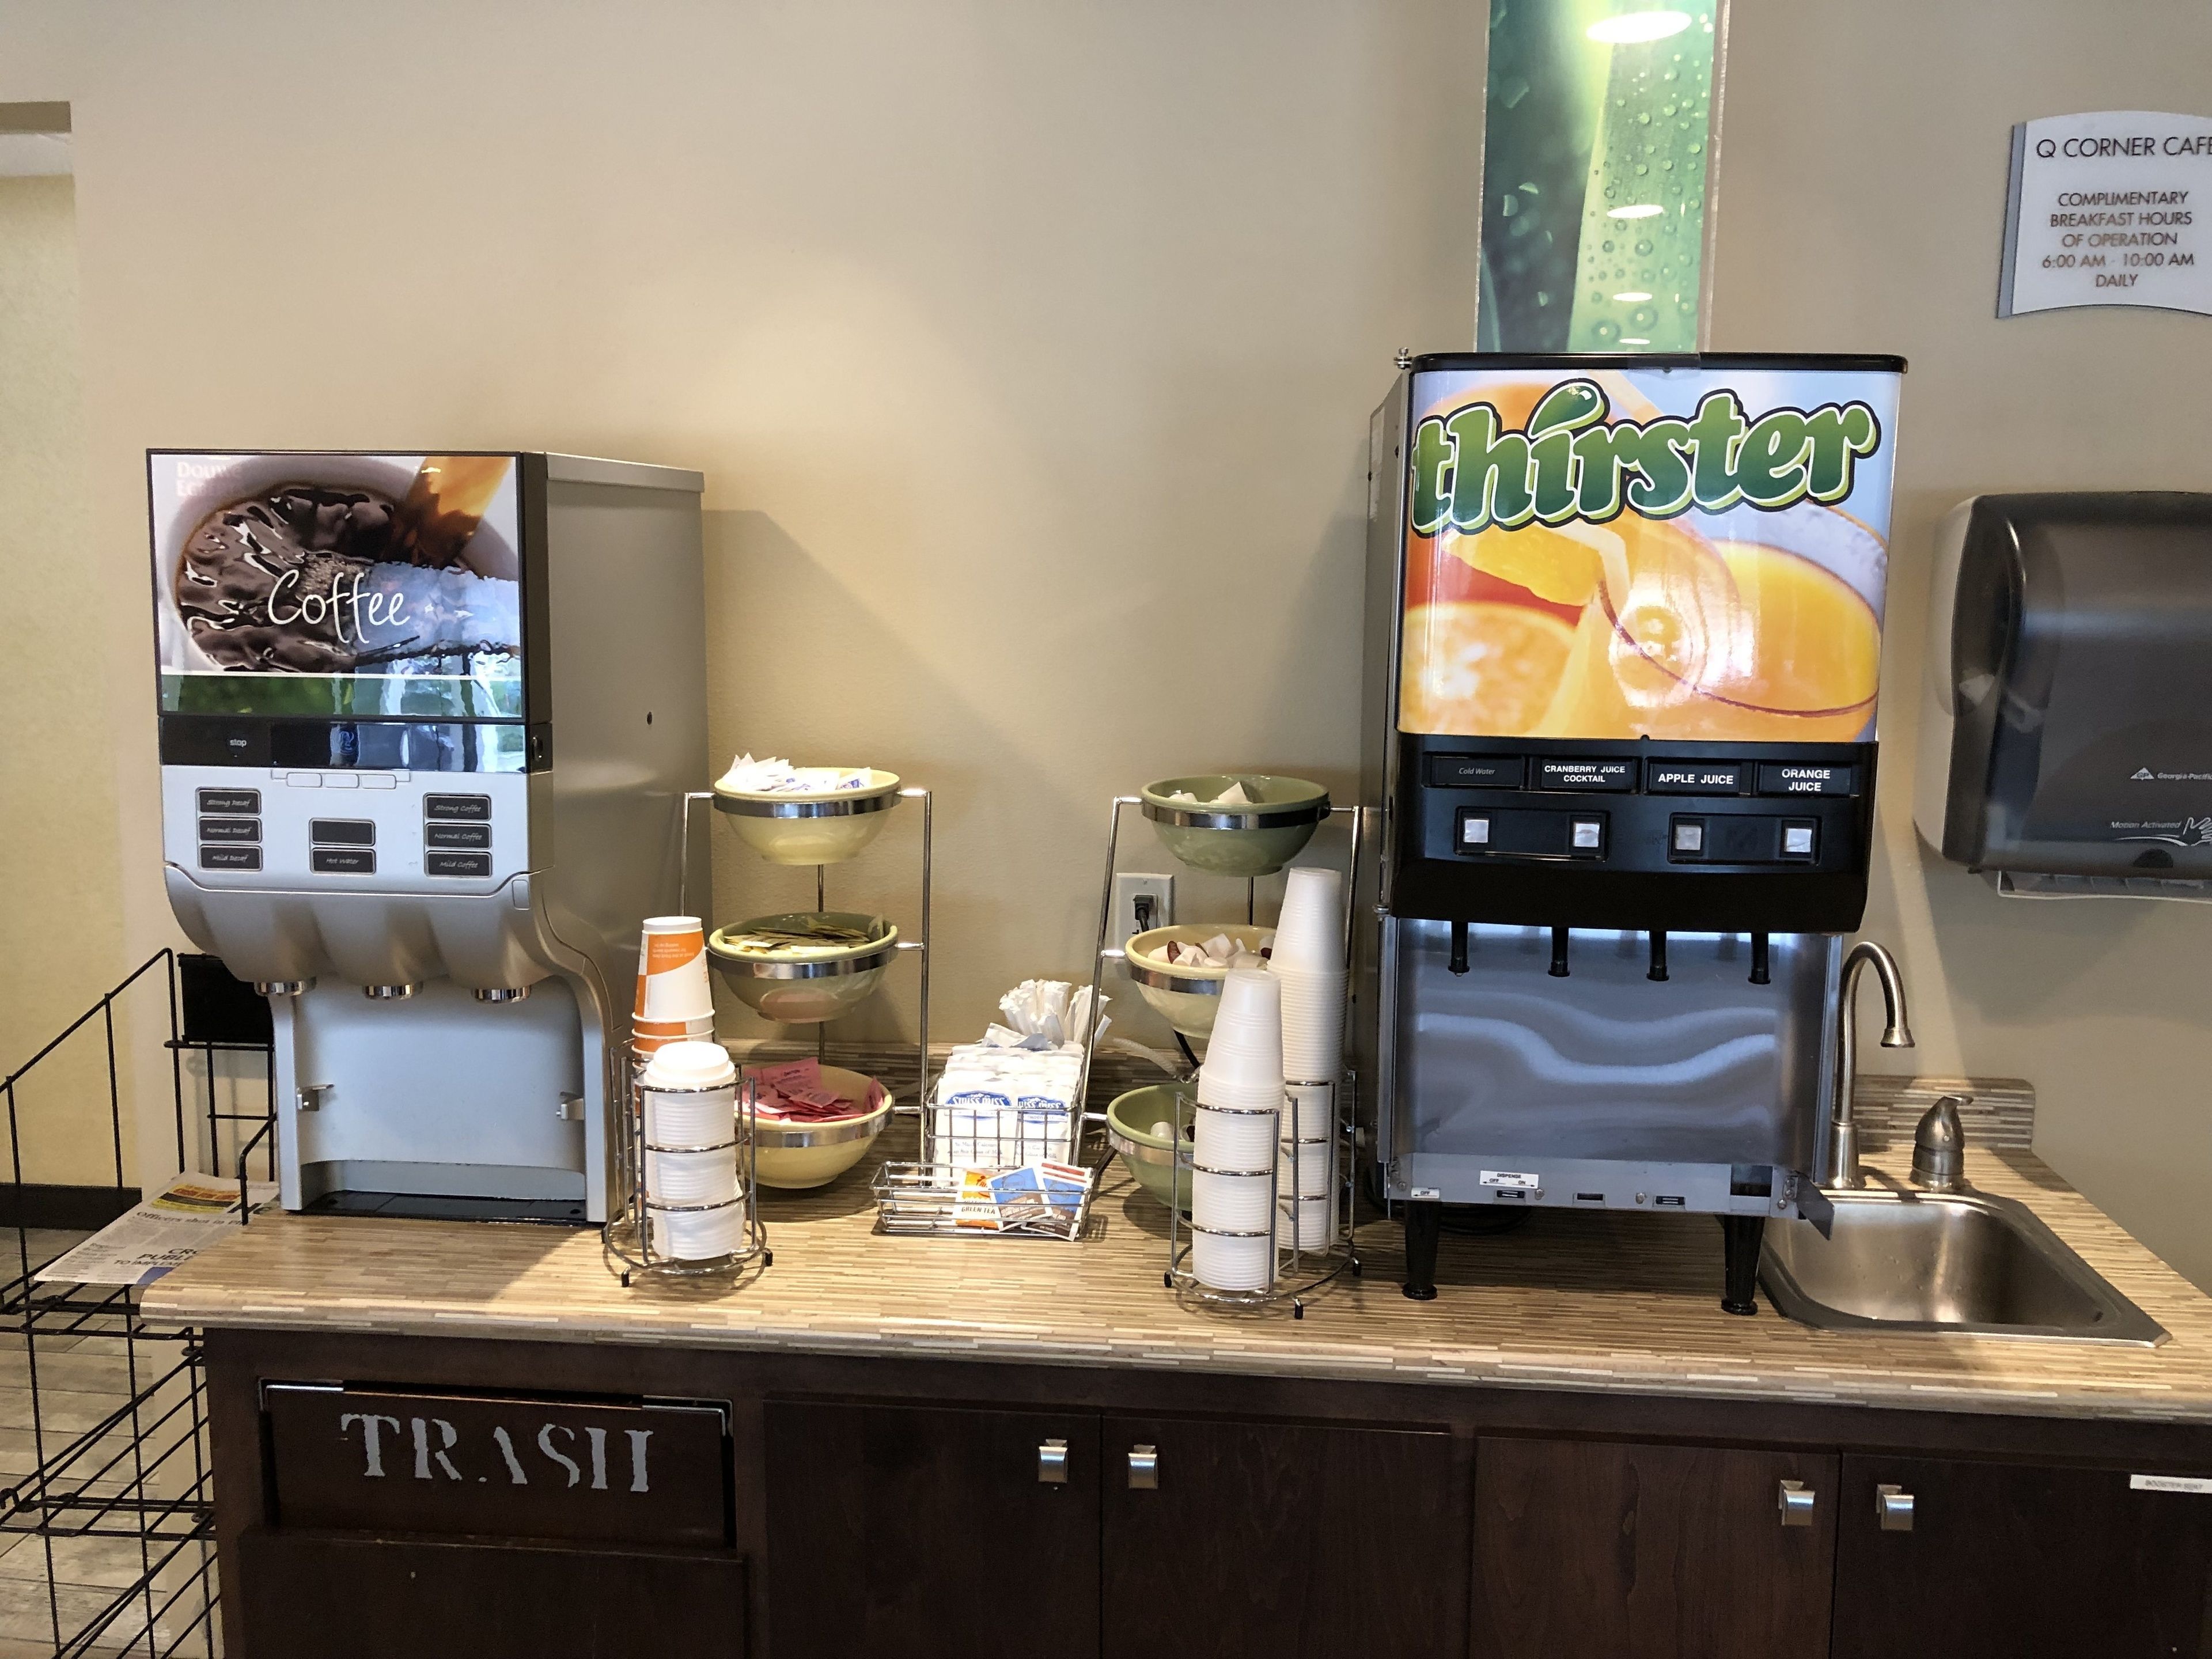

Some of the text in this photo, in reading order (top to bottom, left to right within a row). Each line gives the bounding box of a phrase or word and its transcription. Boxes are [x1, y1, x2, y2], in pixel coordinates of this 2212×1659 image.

[2036, 139, 2056, 158] Q
[2064, 137, 2156, 157] CORNER
[2058, 191, 2189, 206] COMPLIMENTARY
[2051, 212, 2192, 227] BREAKFAST HOURS
[2062, 233, 2178, 248] OF OPERATION
[2042, 255, 2076, 268] 6:00
[2080, 255, 2106, 267] AM
[2124, 253, 2164, 266] 10:00
[2168, 253, 2195, 266] AM
[2096, 274, 2138, 287] DAILY
[1410, 377, 1881, 538] thirster
[268, 569, 410, 643] Coffee
[230, 738, 247, 748] stop
[1544, 765, 1597, 773] CRANBERRY
[1781, 768, 1831, 779] ORANGE
[1563, 775, 1605, 783] COCKTAIL
[1658, 773, 1734, 785] APPLE JUICE
[1788, 782, 1821, 791] JUICE
[434, 805, 482, 813] Strong Coffee
[461, 832, 483, 842] Coffee
[439, 859, 479, 870] Mild Coffee
[137, 1211, 181, 1222] Officers
[340, 1413, 653, 1493] TRASH
